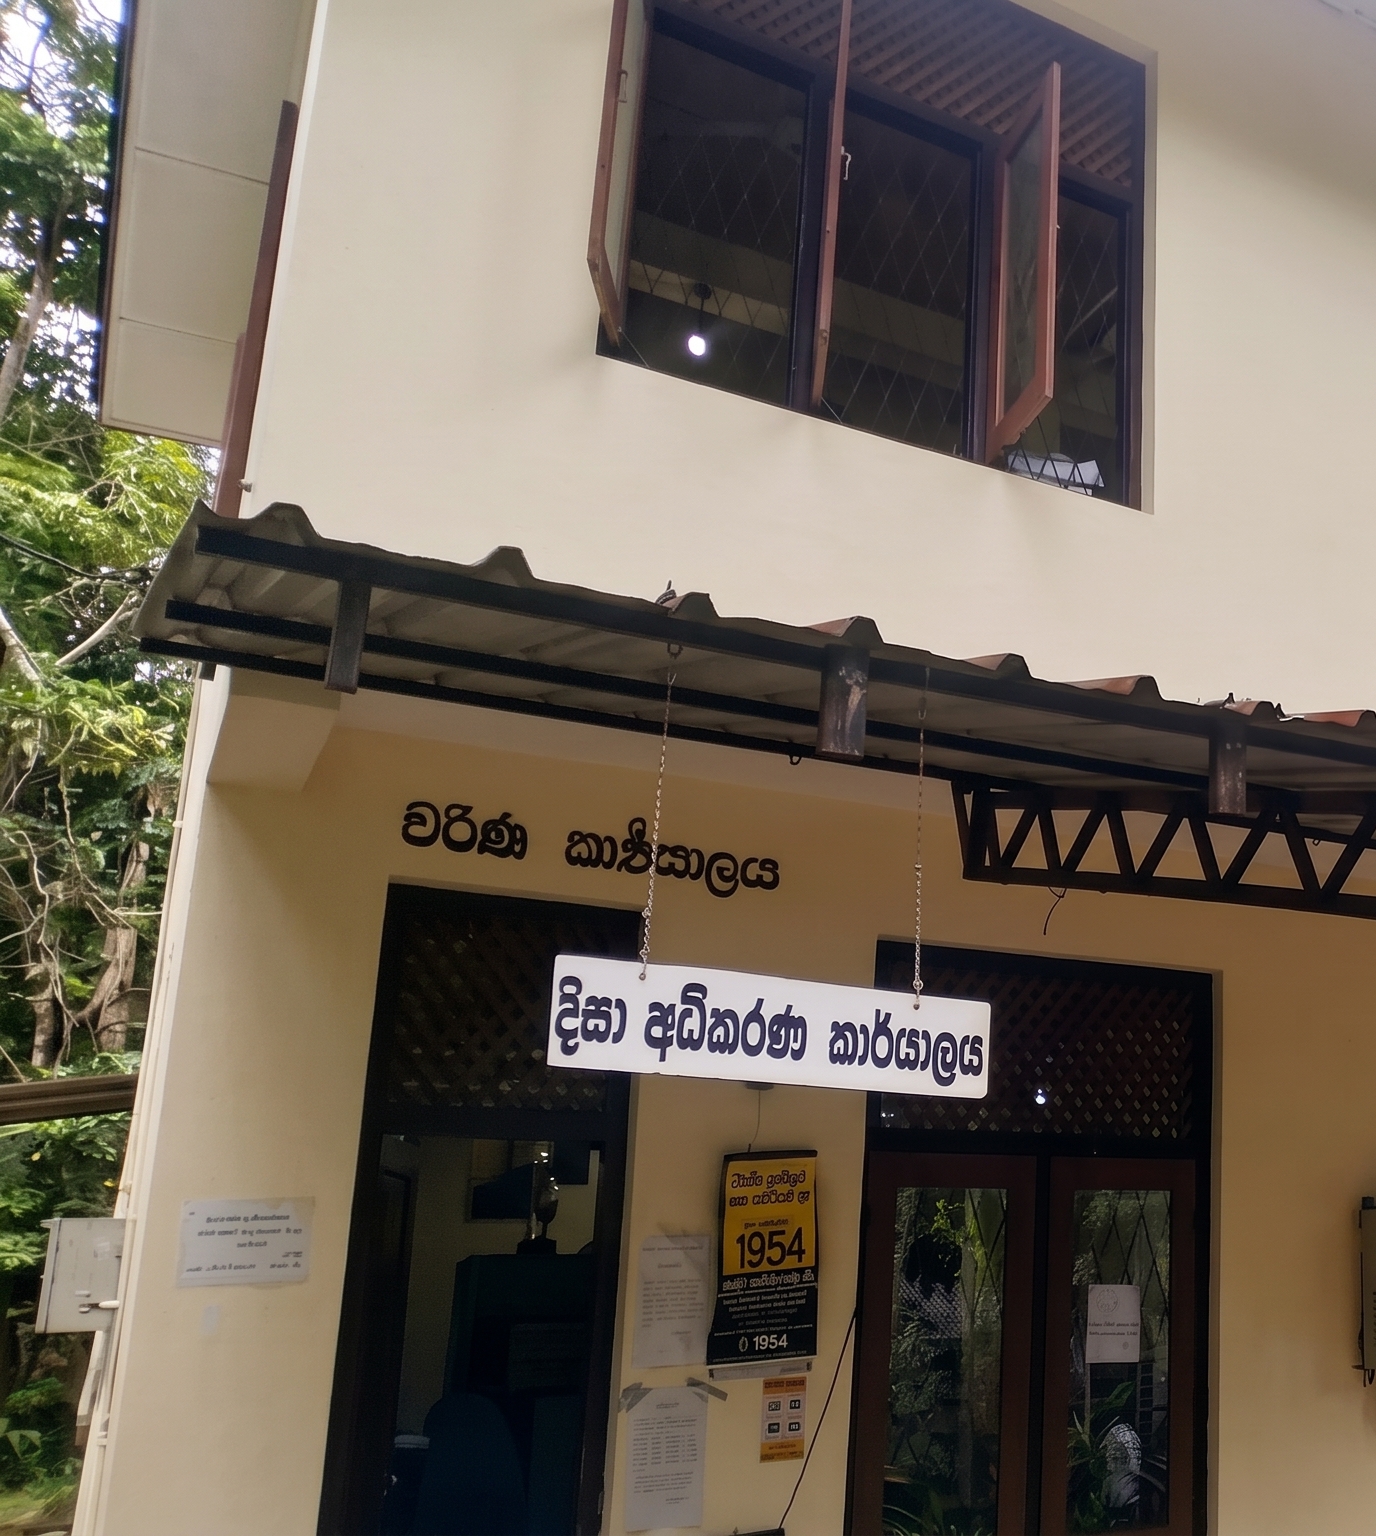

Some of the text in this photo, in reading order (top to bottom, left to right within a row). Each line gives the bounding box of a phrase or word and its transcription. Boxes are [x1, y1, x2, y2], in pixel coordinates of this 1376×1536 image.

[555, 975, 983, 1086] දිසා අධිකරණ කාර්යාලය
[736, 1227, 806, 1269] 1954
[753, 1334, 788, 1350] 1954
